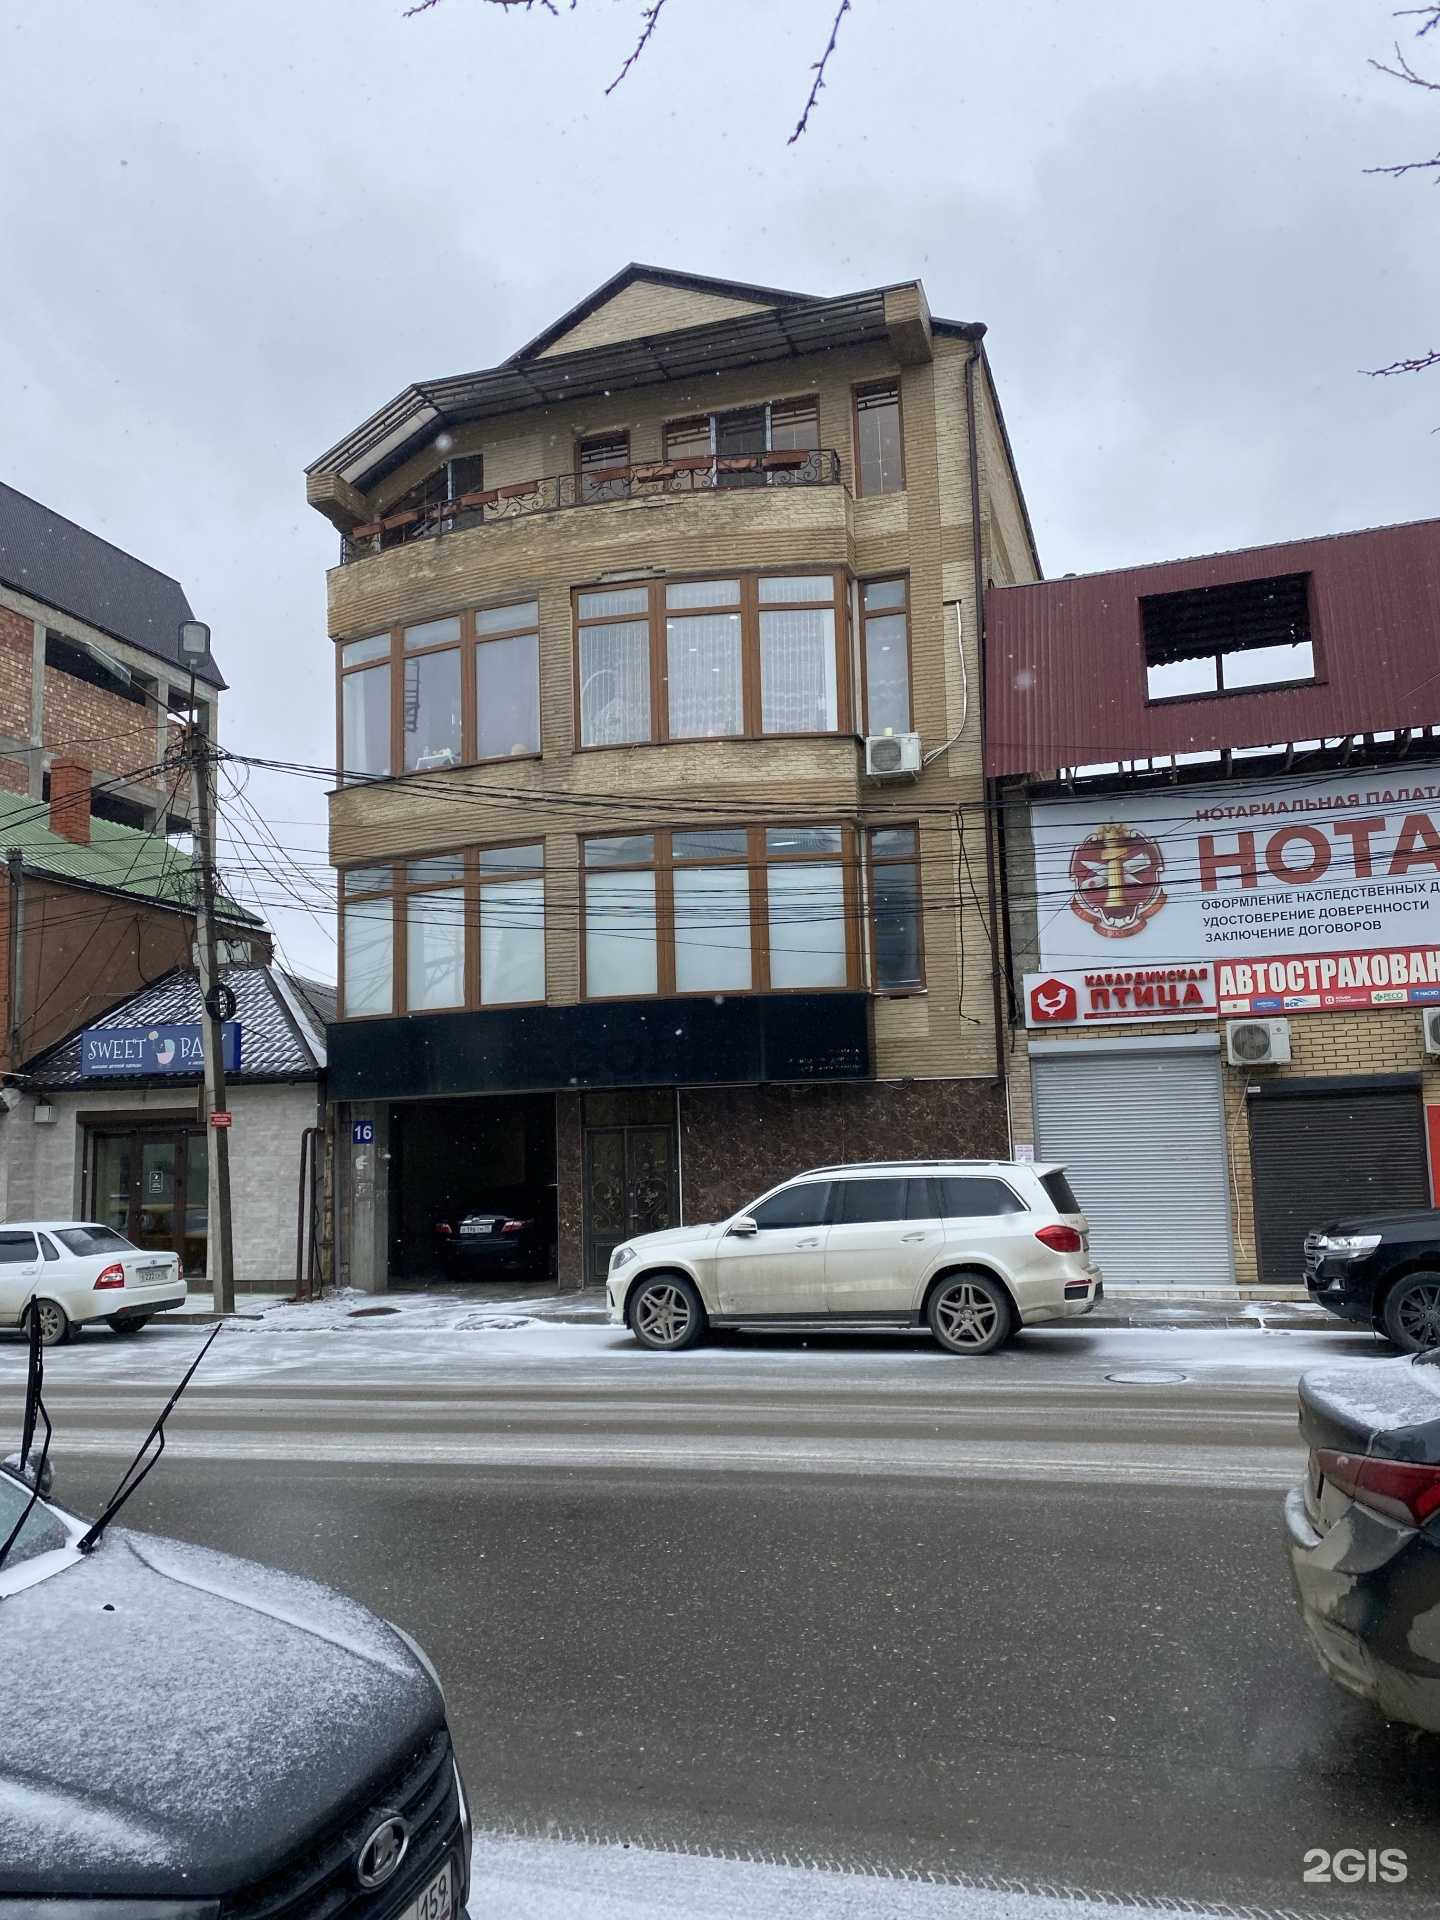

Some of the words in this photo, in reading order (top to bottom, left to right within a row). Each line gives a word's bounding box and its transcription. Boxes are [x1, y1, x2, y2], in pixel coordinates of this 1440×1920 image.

[1196, 793, 1360, 822] НОТАРИАЛЬНАЯ
[1366, 786, 1440, 805] ПАЛАТ
[1197, 813, 1440, 892] НОТА
[1201, 893, 1293, 911] ОФОРМЛЕНИЕ
[1296, 883, 1426, 903] НАСЛЕДСТВЕННЫХ
[1203, 910, 1315, 928] УДОСТОВЕРЕНИЕ
[1318, 900, 1429, 919] ДОВЕРЕННОСТИ
[1205, 926, 1295, 943] ЗАКЛЮЧЕНИЕ
[1298, 920, 1382, 937] ДОГОВОРОВ
[1084, 967, 1208, 987] КАБАРДИНСКАЯ
[1219, 950, 1440, 996] АВТОСТРАХОВАН
[1090, 983, 1204, 1010] ПТИЦА
[88, 1038, 147, 1061] SWEET
[354, 1125, 372, 1140] 16
[420, 1874, 448, 1920] 159
